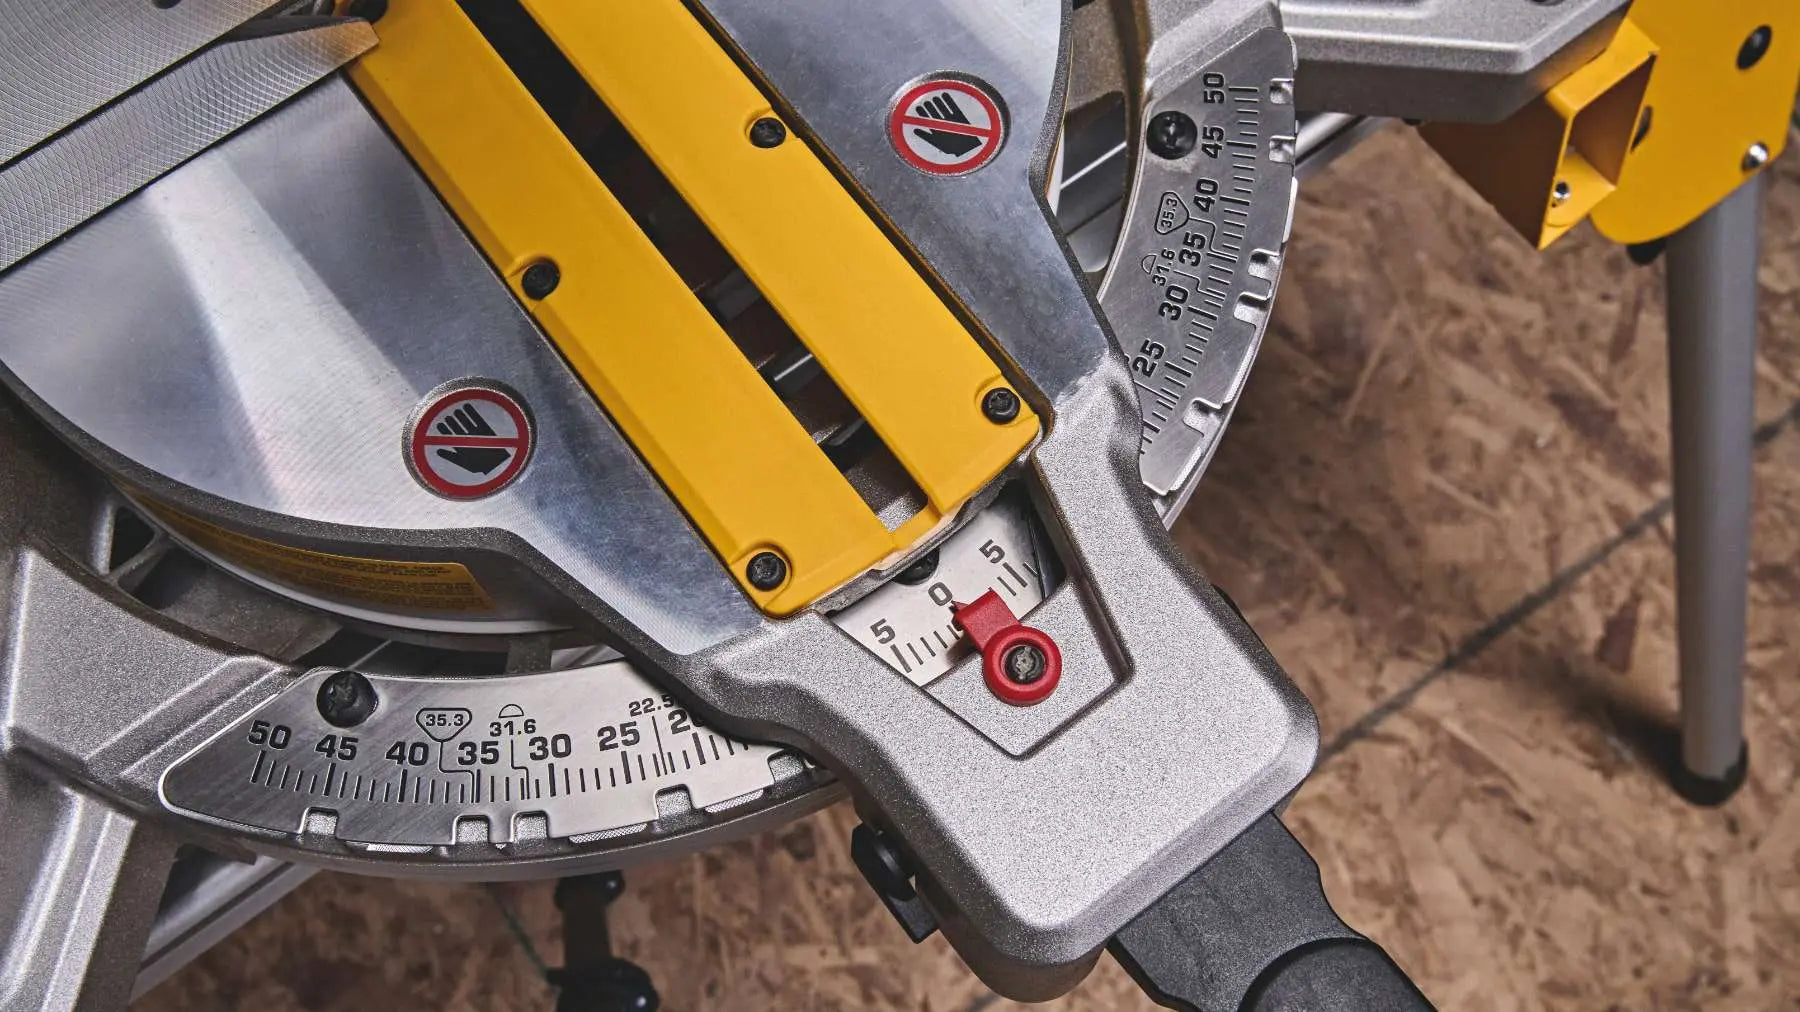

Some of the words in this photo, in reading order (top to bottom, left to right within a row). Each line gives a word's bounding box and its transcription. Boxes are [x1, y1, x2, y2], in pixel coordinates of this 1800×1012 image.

[1203, 71, 1225, 104] 50
[1202, 125, 1225, 159] 45
[1193, 177, 1219, 213] 40
[1161, 197, 1178, 229] 35.3
[1179, 231, 1207, 267] 35
[1152, 248, 1176, 287] 31.6
[1159, 284, 1189, 321] 30
[1132, 338, 1166, 378] 25
[979, 539, 1005, 563] 5
[927, 581, 953, 606] 0
[870, 618, 896, 644] 5
[628, 694, 674, 717] 22.5
[425, 713, 464, 727] 35.3
[489, 718, 537, 737] 31.6
[668, 709, 705, 734] 2
[248, 719, 292, 750] 50
[314, 733, 360, 761] 45
[528, 733, 572, 761] 30
[597, 720, 641, 752] 25
[385, 740, 430, 767] 40
[457, 740, 500, 766] 35
